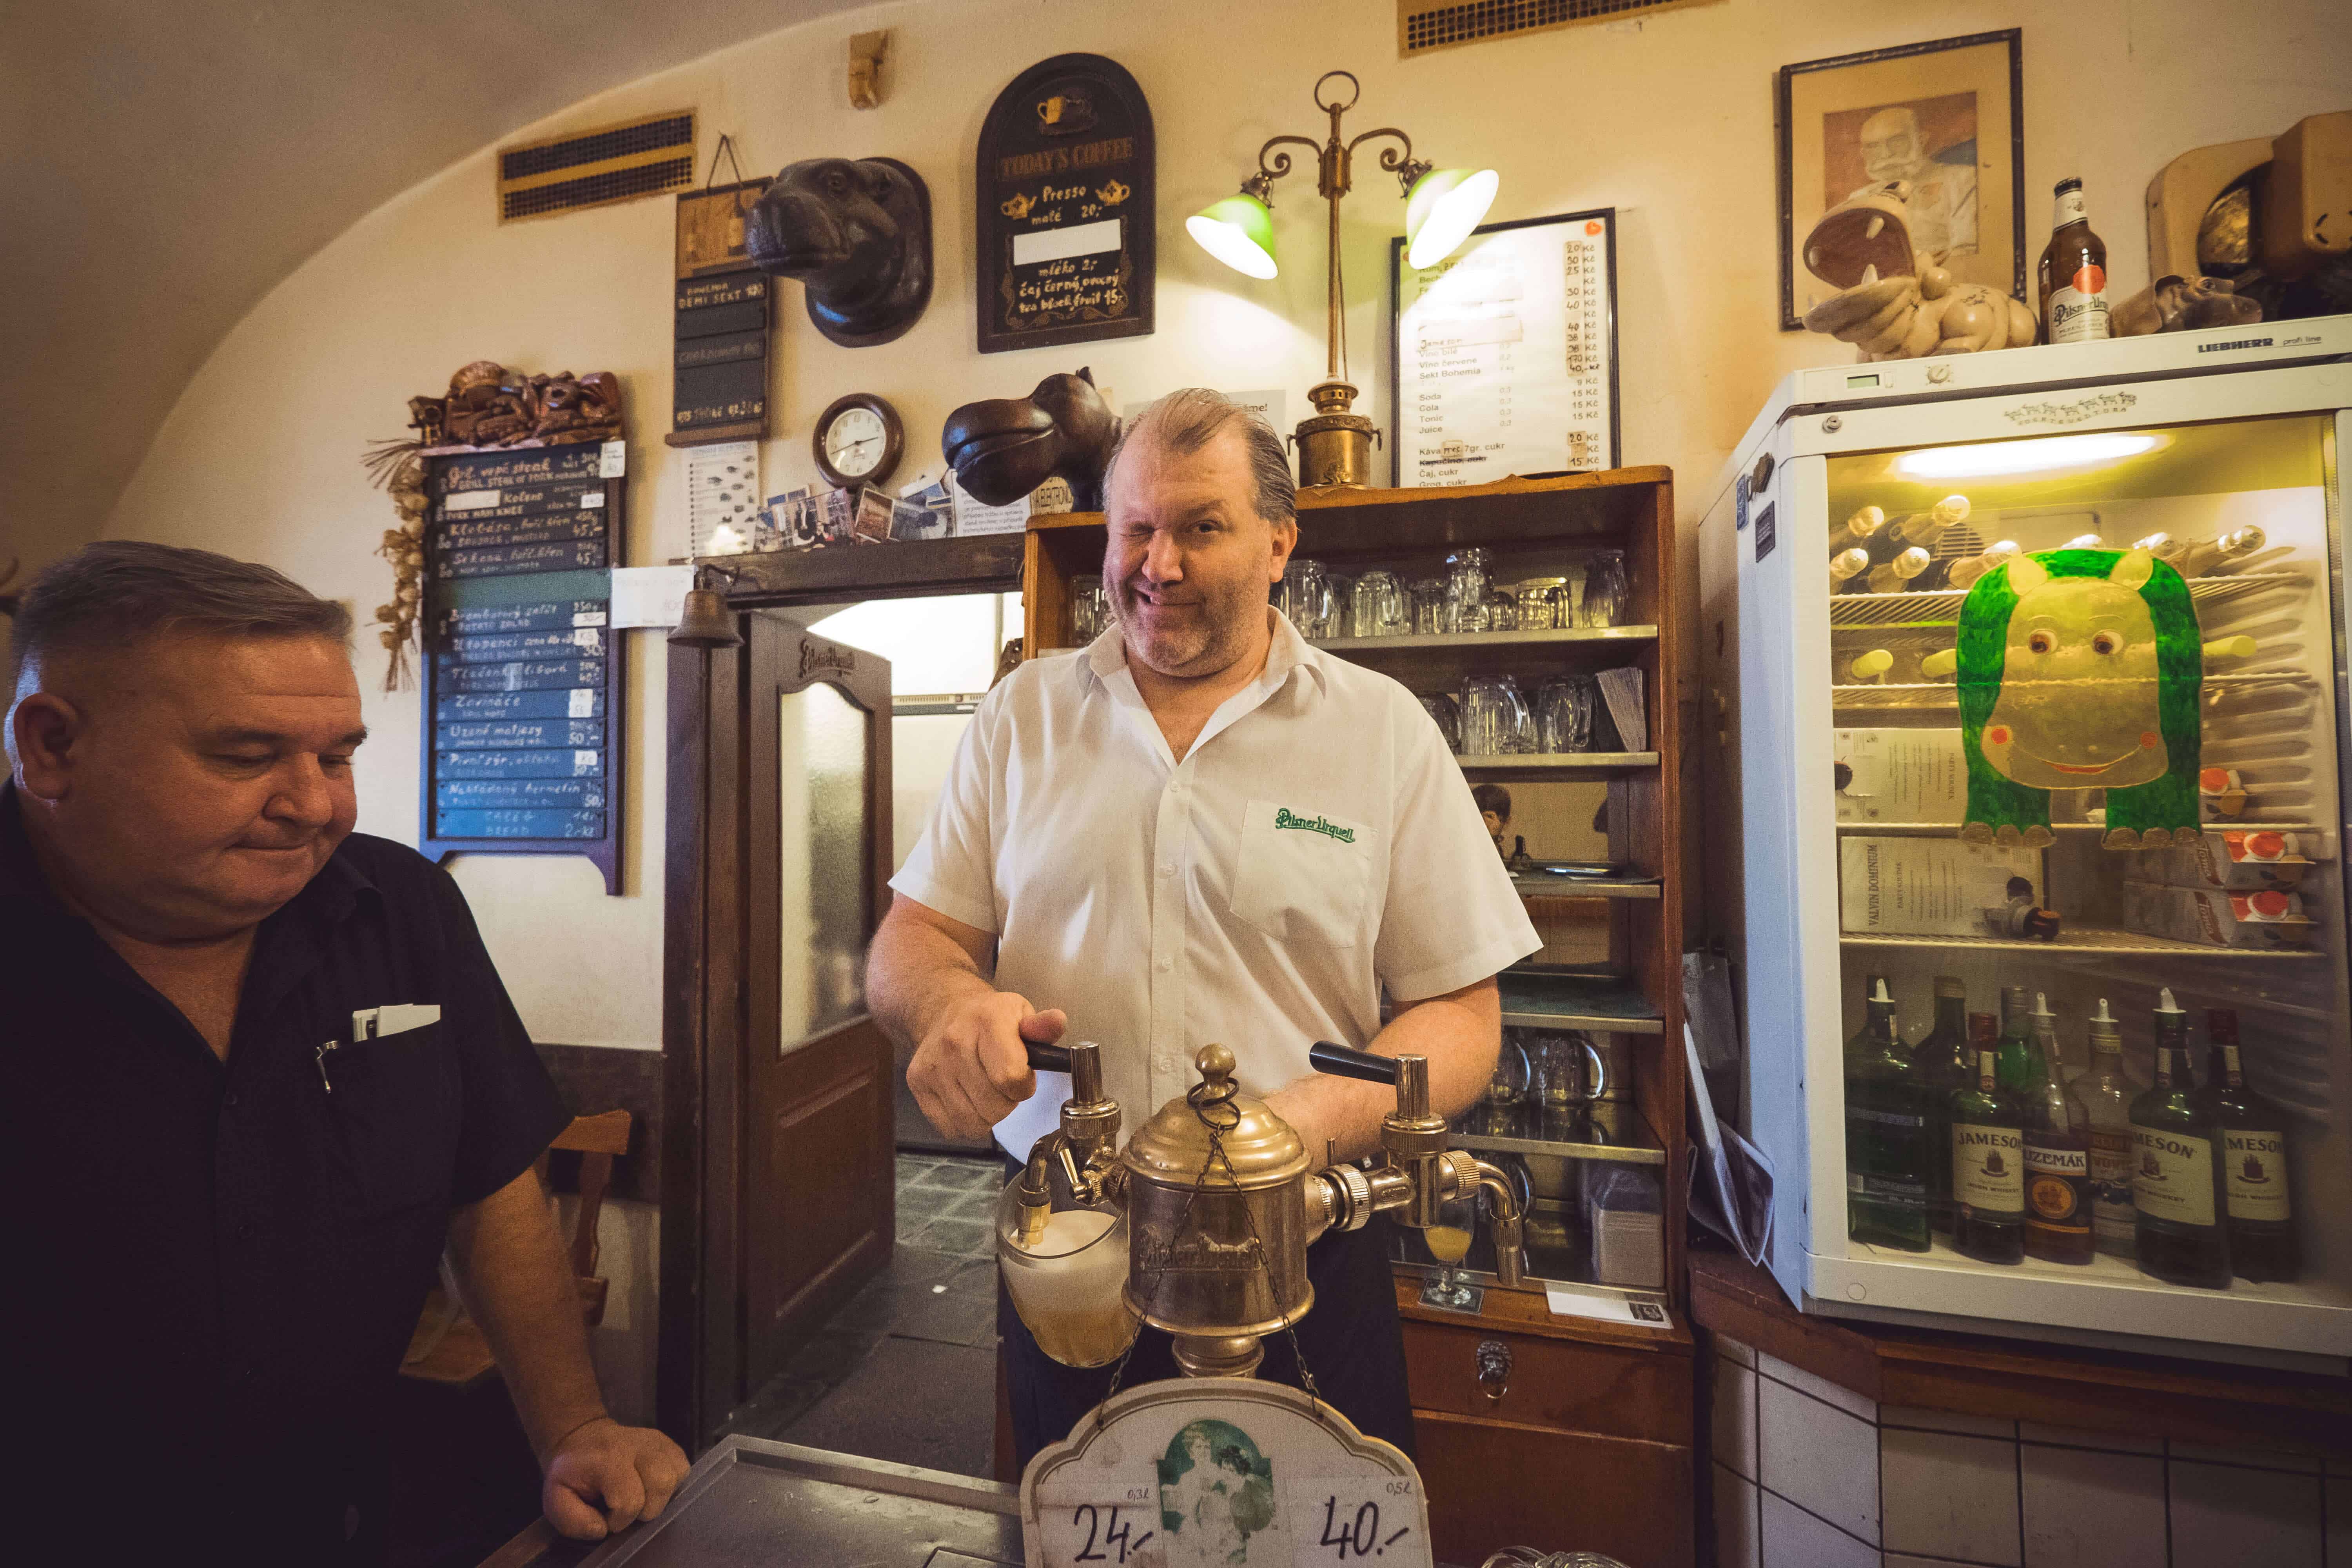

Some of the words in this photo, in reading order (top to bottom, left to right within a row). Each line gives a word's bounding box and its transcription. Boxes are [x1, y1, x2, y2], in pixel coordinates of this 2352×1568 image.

[1001, 148, 1068, 177] TODAY'S
[1073, 137, 1132, 169] COFFEE
[1042, 185, 1087, 202] Presso
[1567, 245, 1579, 253] 20
[1584, 265, 1596, 273] Kč
[1566, 301, 1580, 310] 40
[2198, 337, 2274, 353] LIEBHERR
[1585, 354, 1598, 362] Kč
[1419, 371, 1439, 380] Sekt
[1441, 368, 1481, 379] Bohemia
[1419, 392, 1442, 401] Soda
[1419, 404, 1439, 412] Cola
[1419, 414, 1444, 423] Tonic
[1419, 425, 1443, 434] Juice
[1419, 446, 1441, 456] Káva
[1485, 441, 1505, 451] cukr
[1570, 433, 1583, 443] 20
[1586, 433, 1599, 442] Kč
[1587, 445, 1600, 453] Kč
[1438, 468, 1458, 476] cukr
[1587, 456, 1600, 465] Kč
[1446, 478, 1467, 487] cukr
[1276, 808, 1318, 829] Pilsner
[1317, 816, 1354, 838] Urquell
[1866, 844, 1879, 892] DOMINIUM
[1868, 894, 1880, 926] VALVIN
[2133, 1131, 2194, 1160] MESON
[2225, 1138, 2282, 1153] MESO
[2023, 1148, 2085, 1167] UZEMÁK
